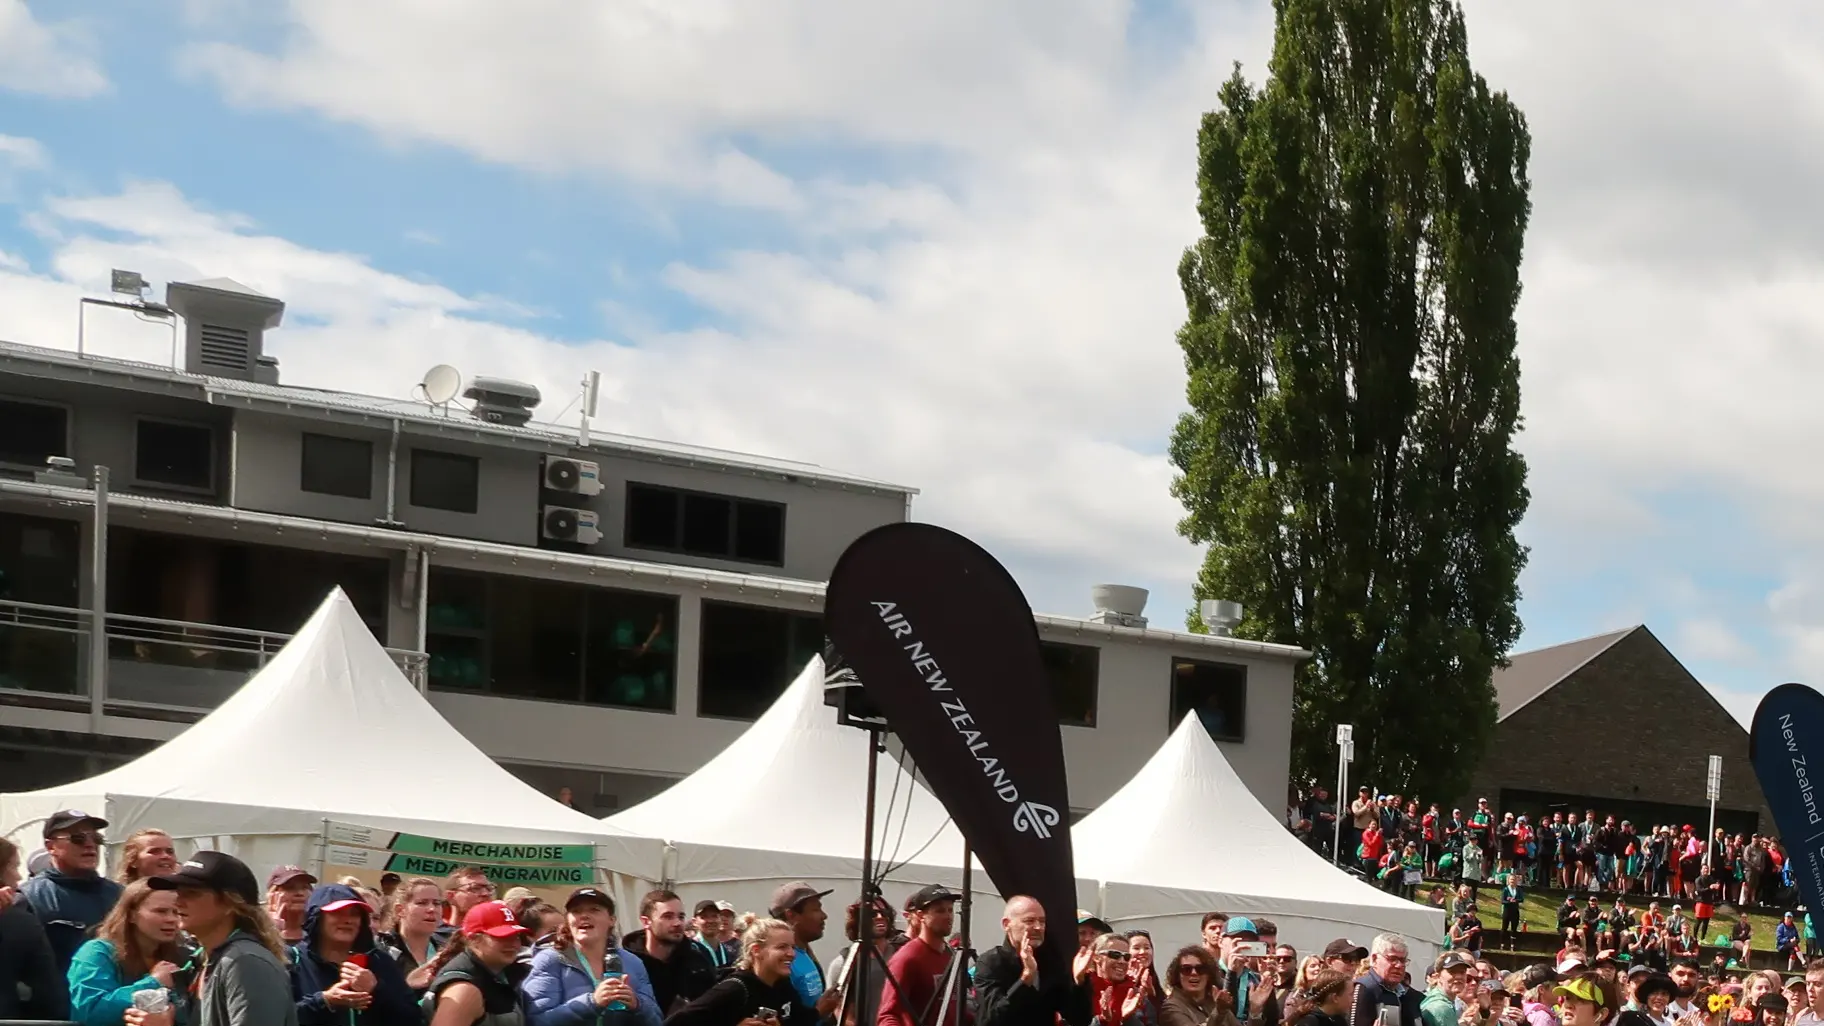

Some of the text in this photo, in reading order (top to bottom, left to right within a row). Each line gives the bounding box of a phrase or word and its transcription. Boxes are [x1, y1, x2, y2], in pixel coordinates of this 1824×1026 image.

[870, 600, 1019, 803] AIR NEW ZEALAND
[1778, 713, 1822, 826] New Zealand
[405, 857, 582, 882] MEDA ENGRAVING
[432, 840, 563, 859] MERCHANDISE
